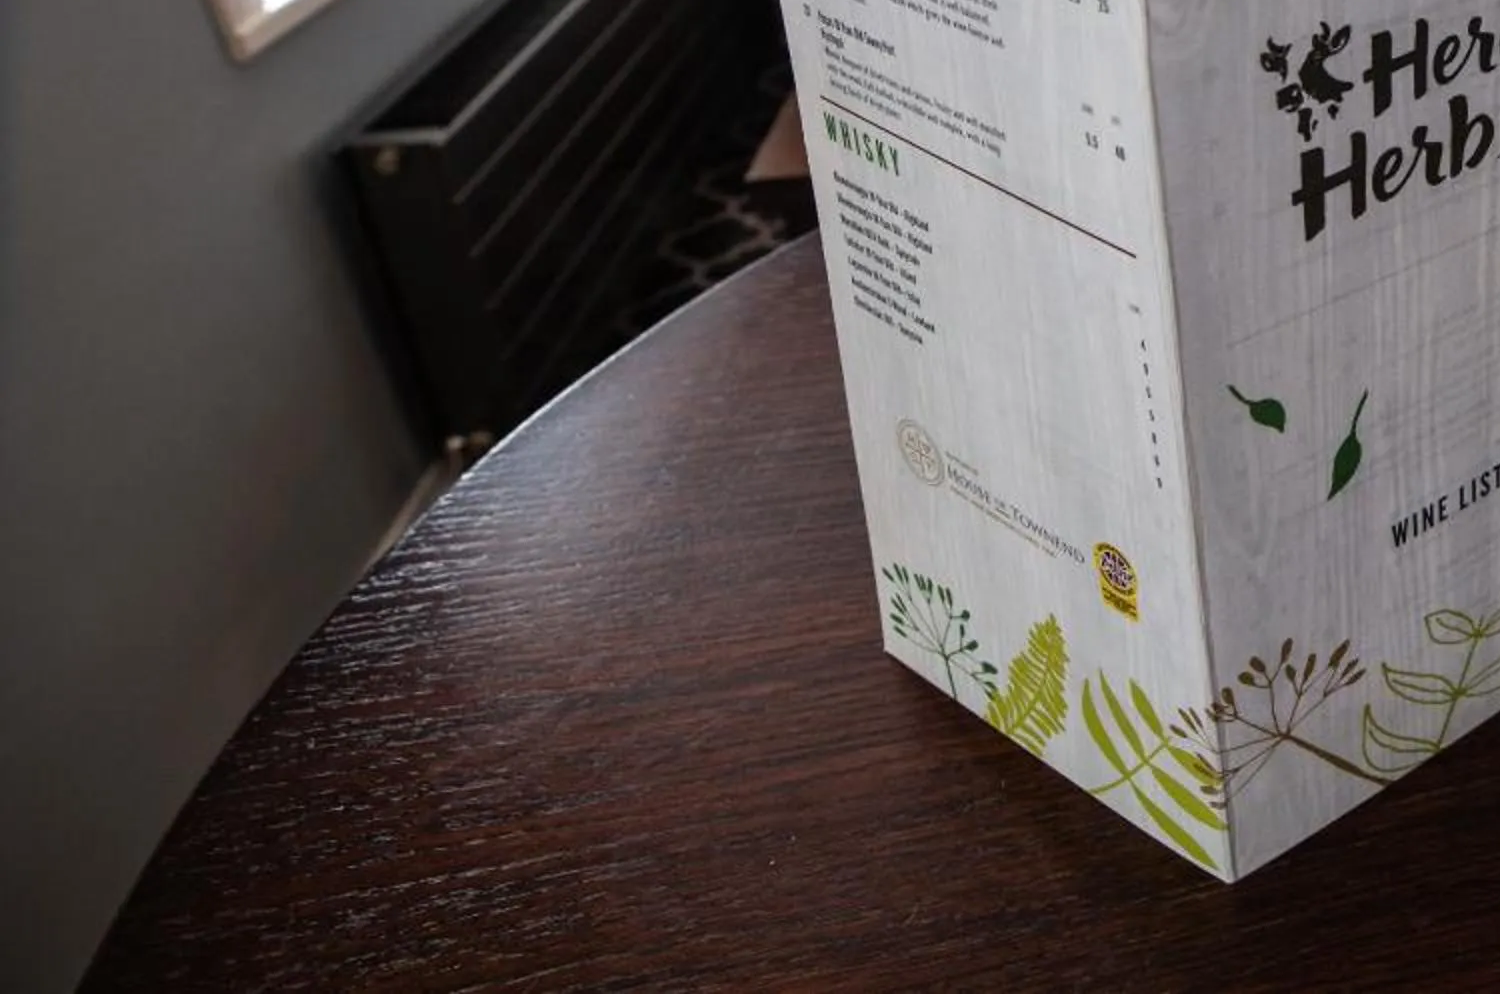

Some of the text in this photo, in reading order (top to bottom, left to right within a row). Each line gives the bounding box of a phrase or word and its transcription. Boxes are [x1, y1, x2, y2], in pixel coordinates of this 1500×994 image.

[822, 110, 901, 177] WHISKY
[1291, 94, 1495, 242] Herb
[1391, 494, 1450, 548] WINE
